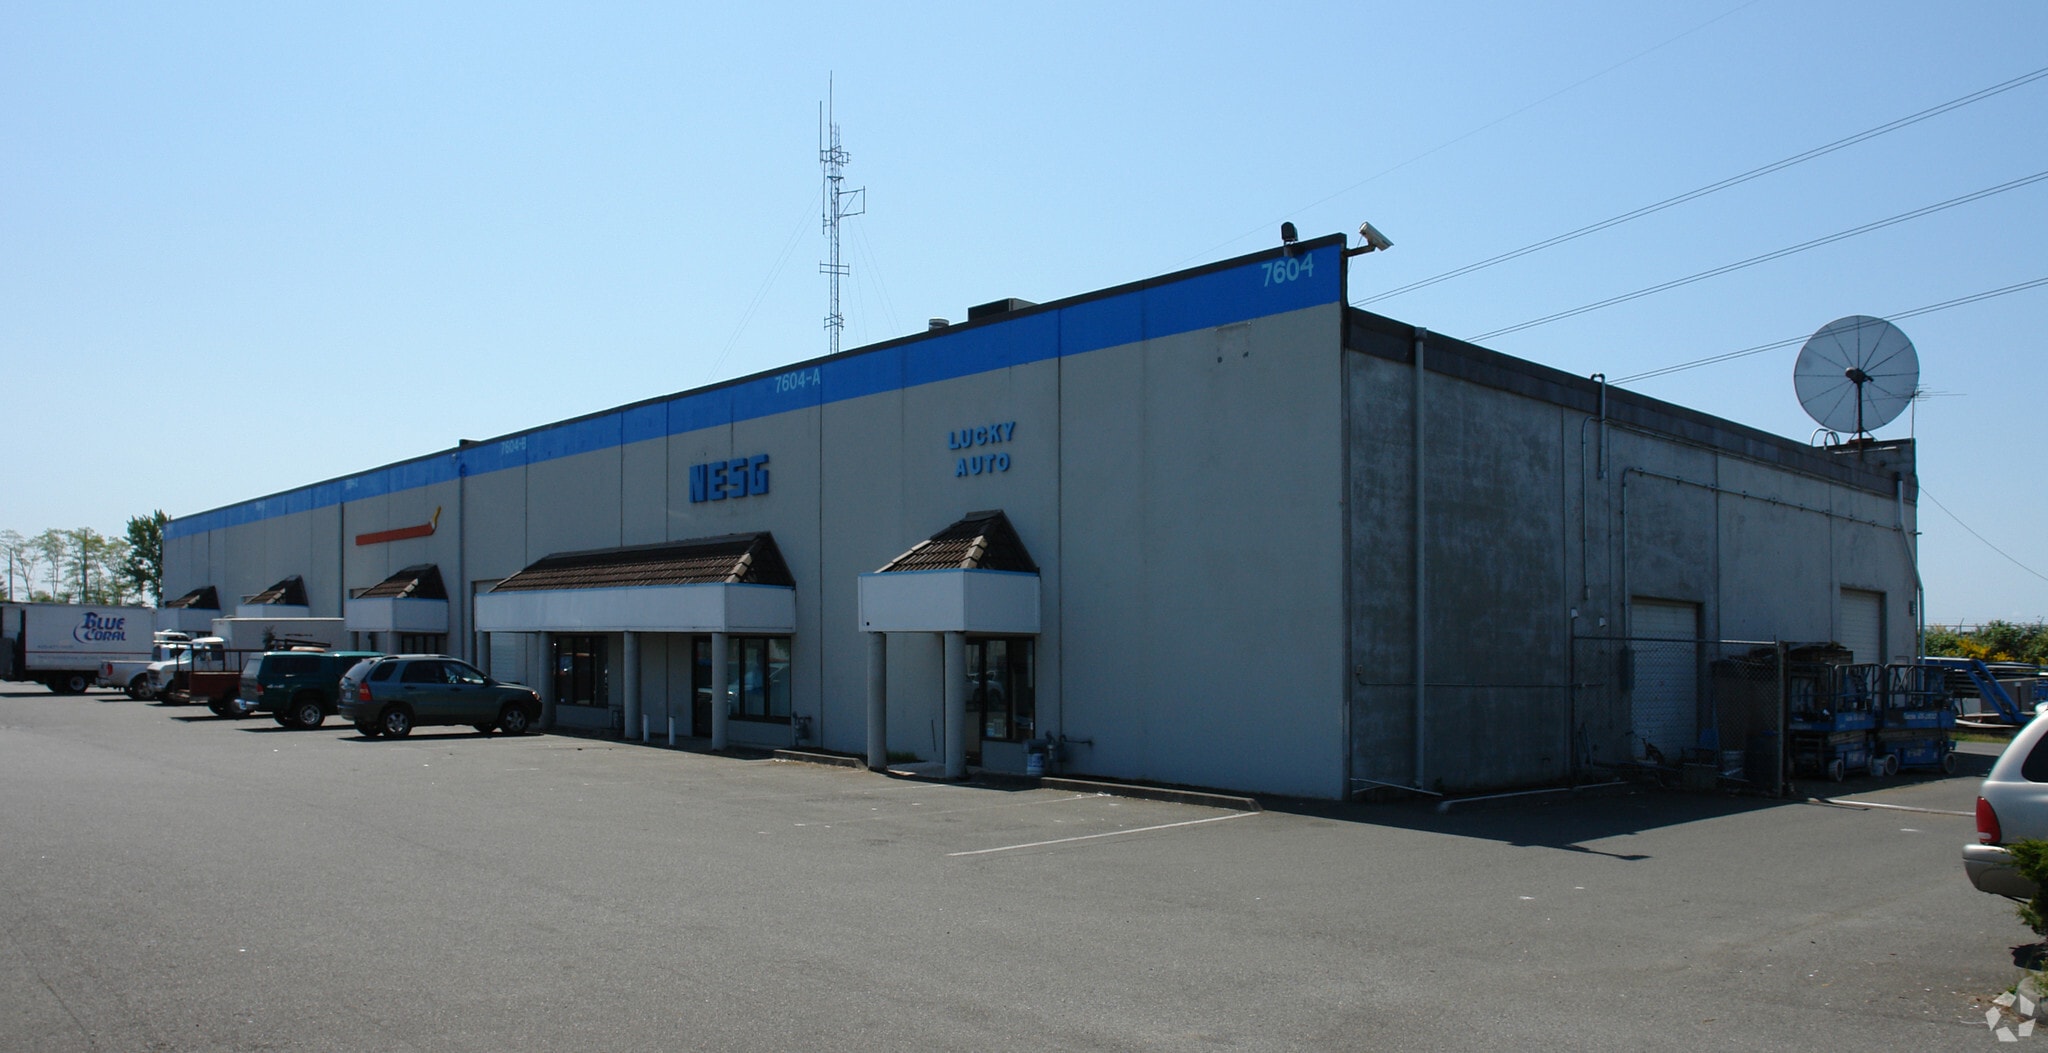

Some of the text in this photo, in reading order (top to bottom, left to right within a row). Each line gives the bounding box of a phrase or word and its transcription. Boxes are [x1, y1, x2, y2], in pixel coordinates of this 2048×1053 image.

[1261, 252, 1314, 287] 7604
[775, 367, 821, 394] 7604-A
[948, 421, 1016, 450] LUCKY
[689, 453, 769, 503] NESG
[955, 452, 1010, 477] AUTO
[81, 611, 126, 630] BLUE
[83, 629, 127, 641] CORAL
